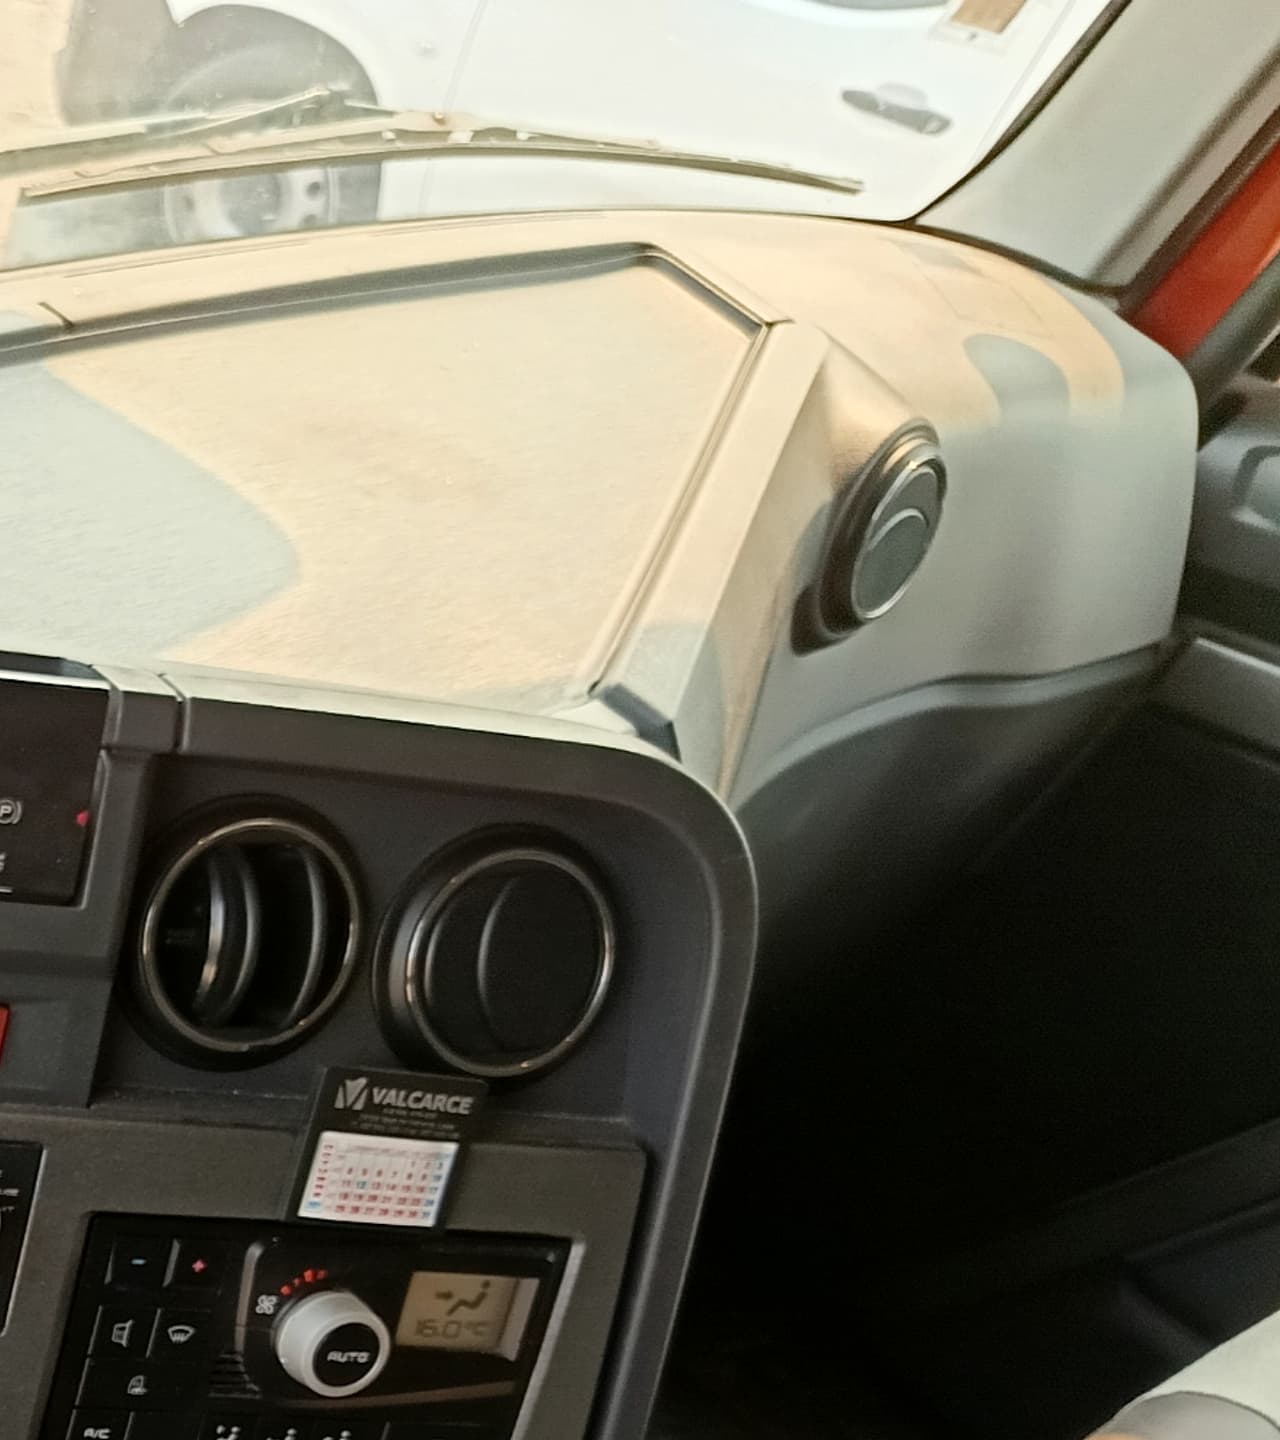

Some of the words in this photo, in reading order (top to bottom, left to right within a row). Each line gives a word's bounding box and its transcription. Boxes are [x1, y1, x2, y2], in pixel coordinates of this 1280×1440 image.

[372, 1087, 475, 1115] VALCARCE
[326, 1350, 371, 1363] AUTO
[83, 1427, 111, 1440] A/C
